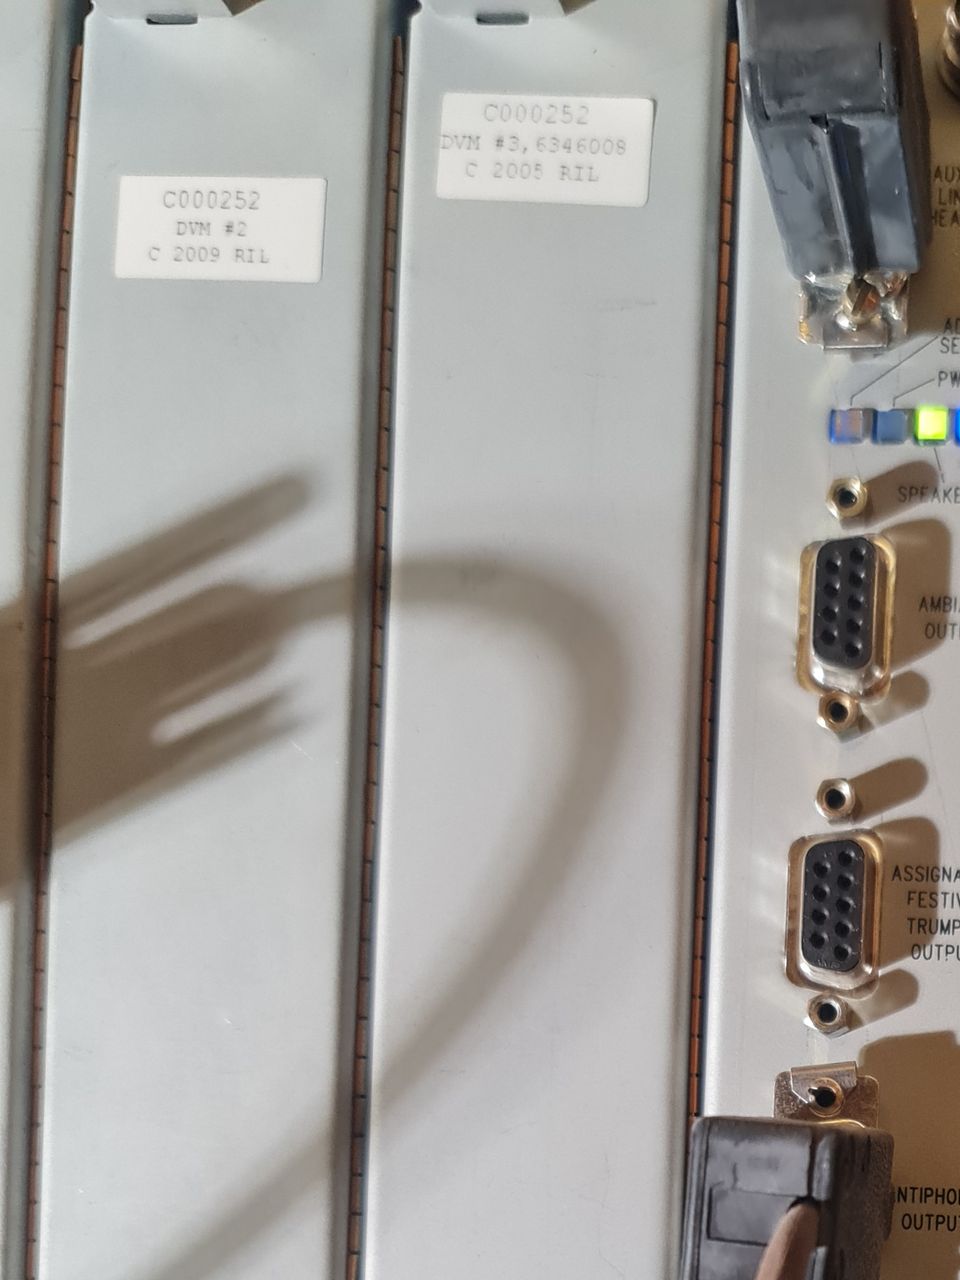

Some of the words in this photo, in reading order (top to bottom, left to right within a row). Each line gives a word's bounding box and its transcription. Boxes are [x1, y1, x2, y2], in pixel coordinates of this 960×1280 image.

[483, 103, 590, 125] C000252
[440, 134, 481, 151] DVM
[559, 165, 600, 182] RIL
[162, 190, 261, 210] C000252
[176, 221, 211, 237] DVM
[224, 221, 247, 237] #2
[173, 246, 220, 263] 2009
[235, 248, 270, 264] RIL
